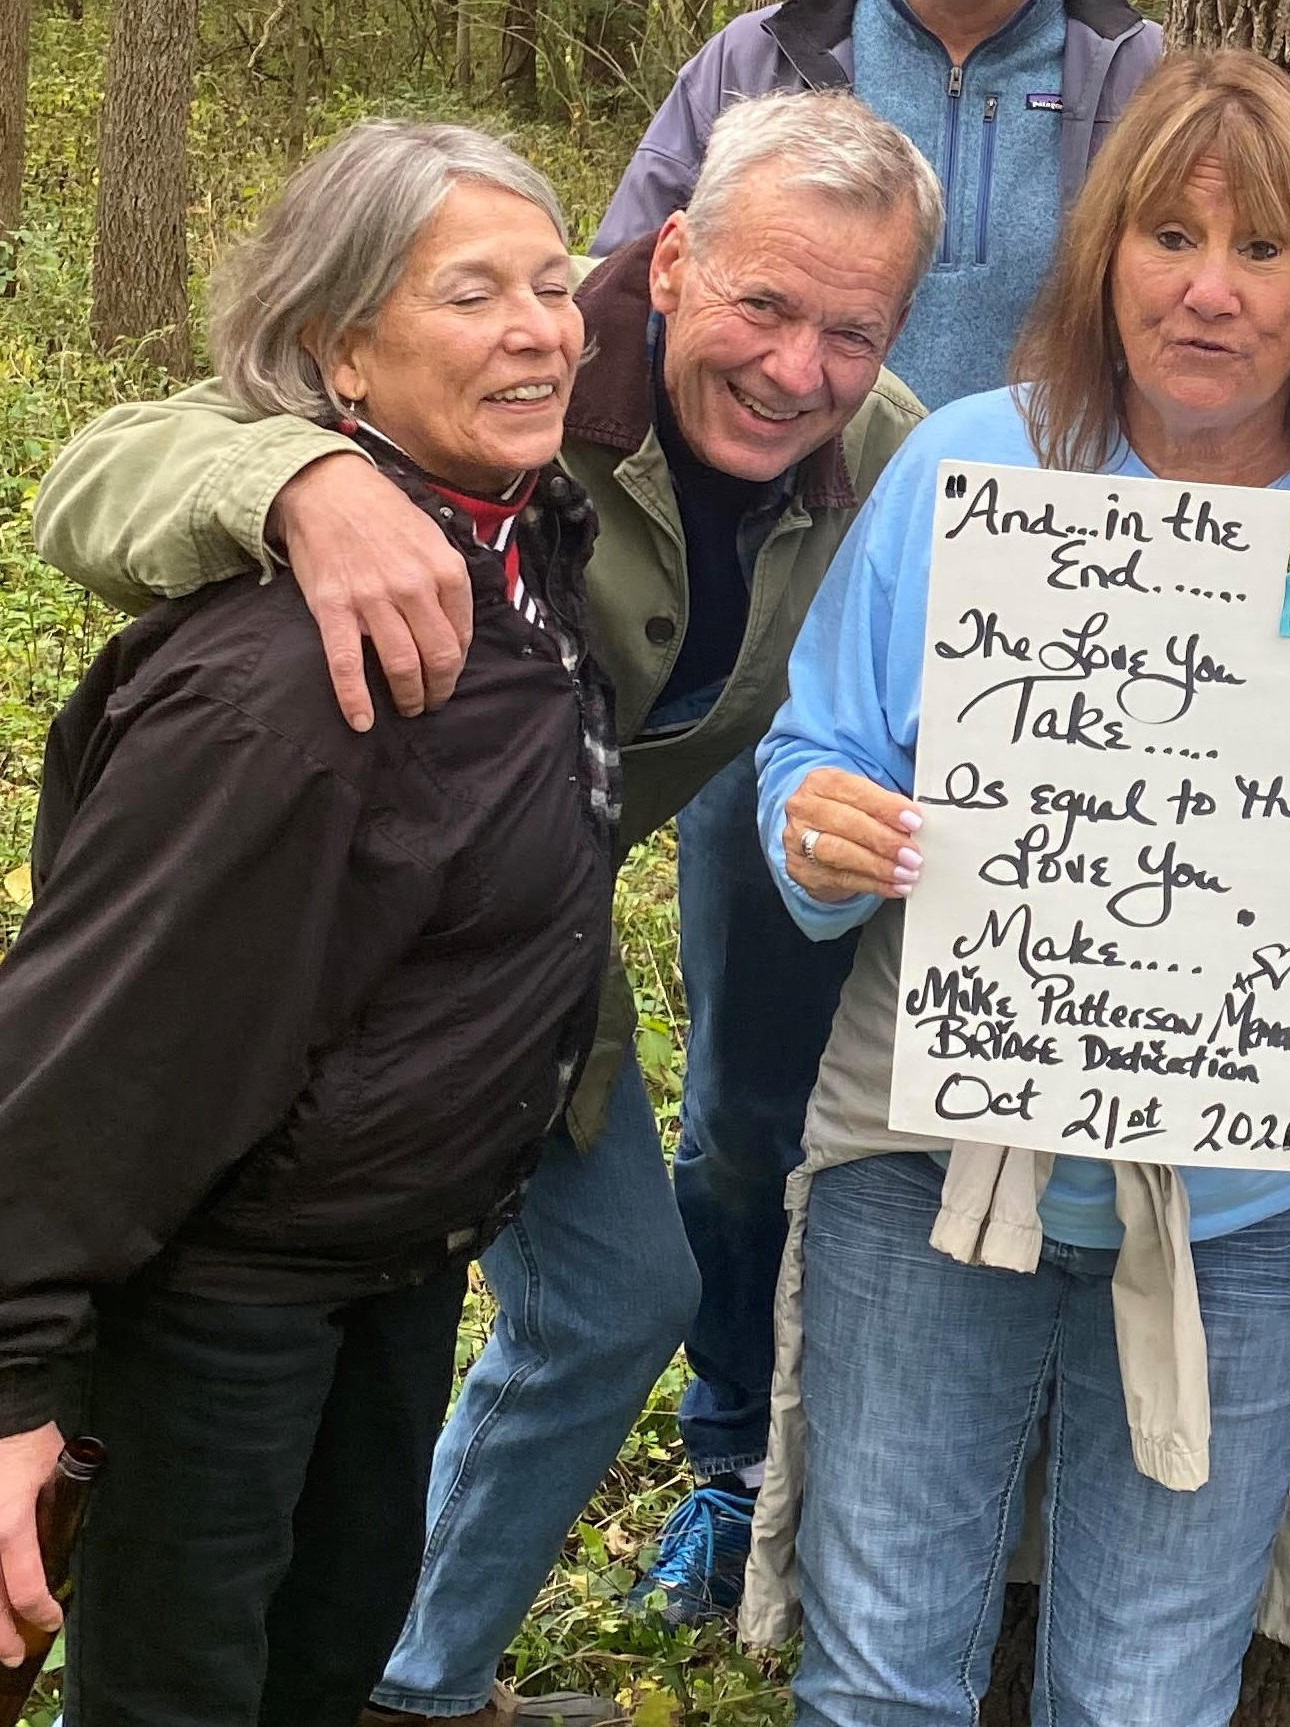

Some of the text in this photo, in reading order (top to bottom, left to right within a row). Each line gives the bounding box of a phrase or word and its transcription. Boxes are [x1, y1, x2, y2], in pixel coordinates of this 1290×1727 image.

[1162, 491, 1251, 552] the
[934, 607, 1033, 661] The
[1038, 611, 1149, 676] Love
[1029, 777, 1158, 856] equal
[1166, 778, 1217, 826] to
[978, 823, 1112, 889] Love
[1030, 972, 1202, 1037] Patterson
[1078, 1034, 1261, 1084] Dedication
[934, 1072, 1041, 1121] Oct
[1061, 1087, 1167, 1150] 21st
